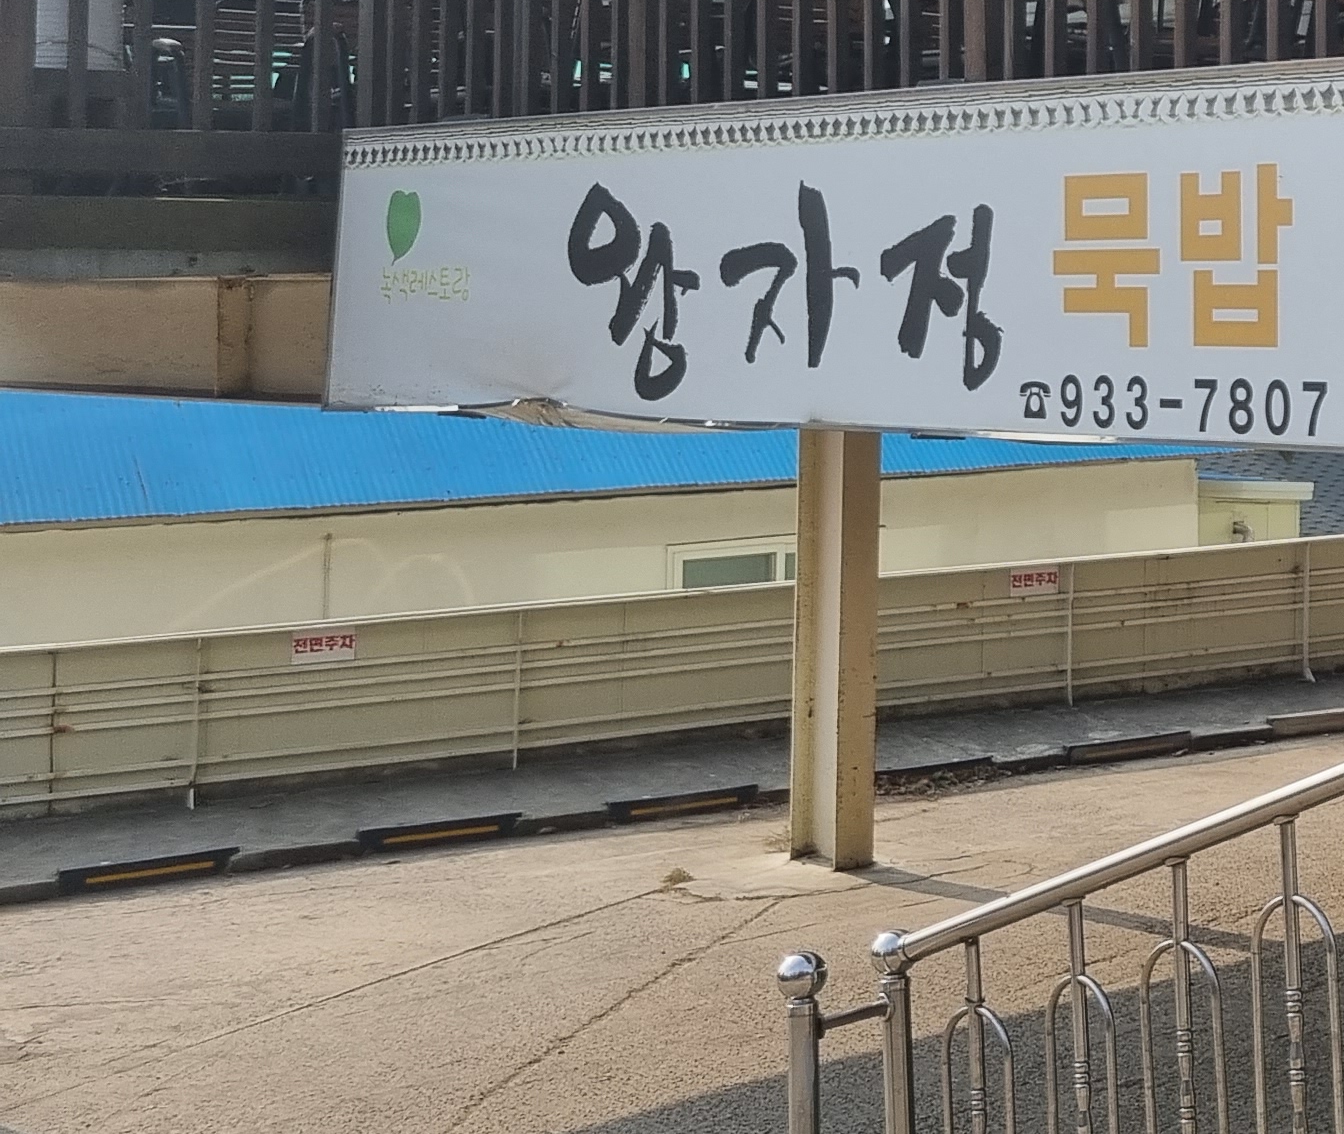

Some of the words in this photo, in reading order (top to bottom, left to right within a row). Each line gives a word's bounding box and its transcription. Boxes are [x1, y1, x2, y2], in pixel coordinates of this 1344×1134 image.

[380, 266, 470, 305] 녹색레스토랑
[567, 180, 1003, 402] 왕자정
[1053, 163, 1294, 349] 묵밥
[1060, 374, 1329, 437] 933-7807
[1011, 571, 1059, 589] 전면주차
[293, 633, 356, 655] 전면주차
